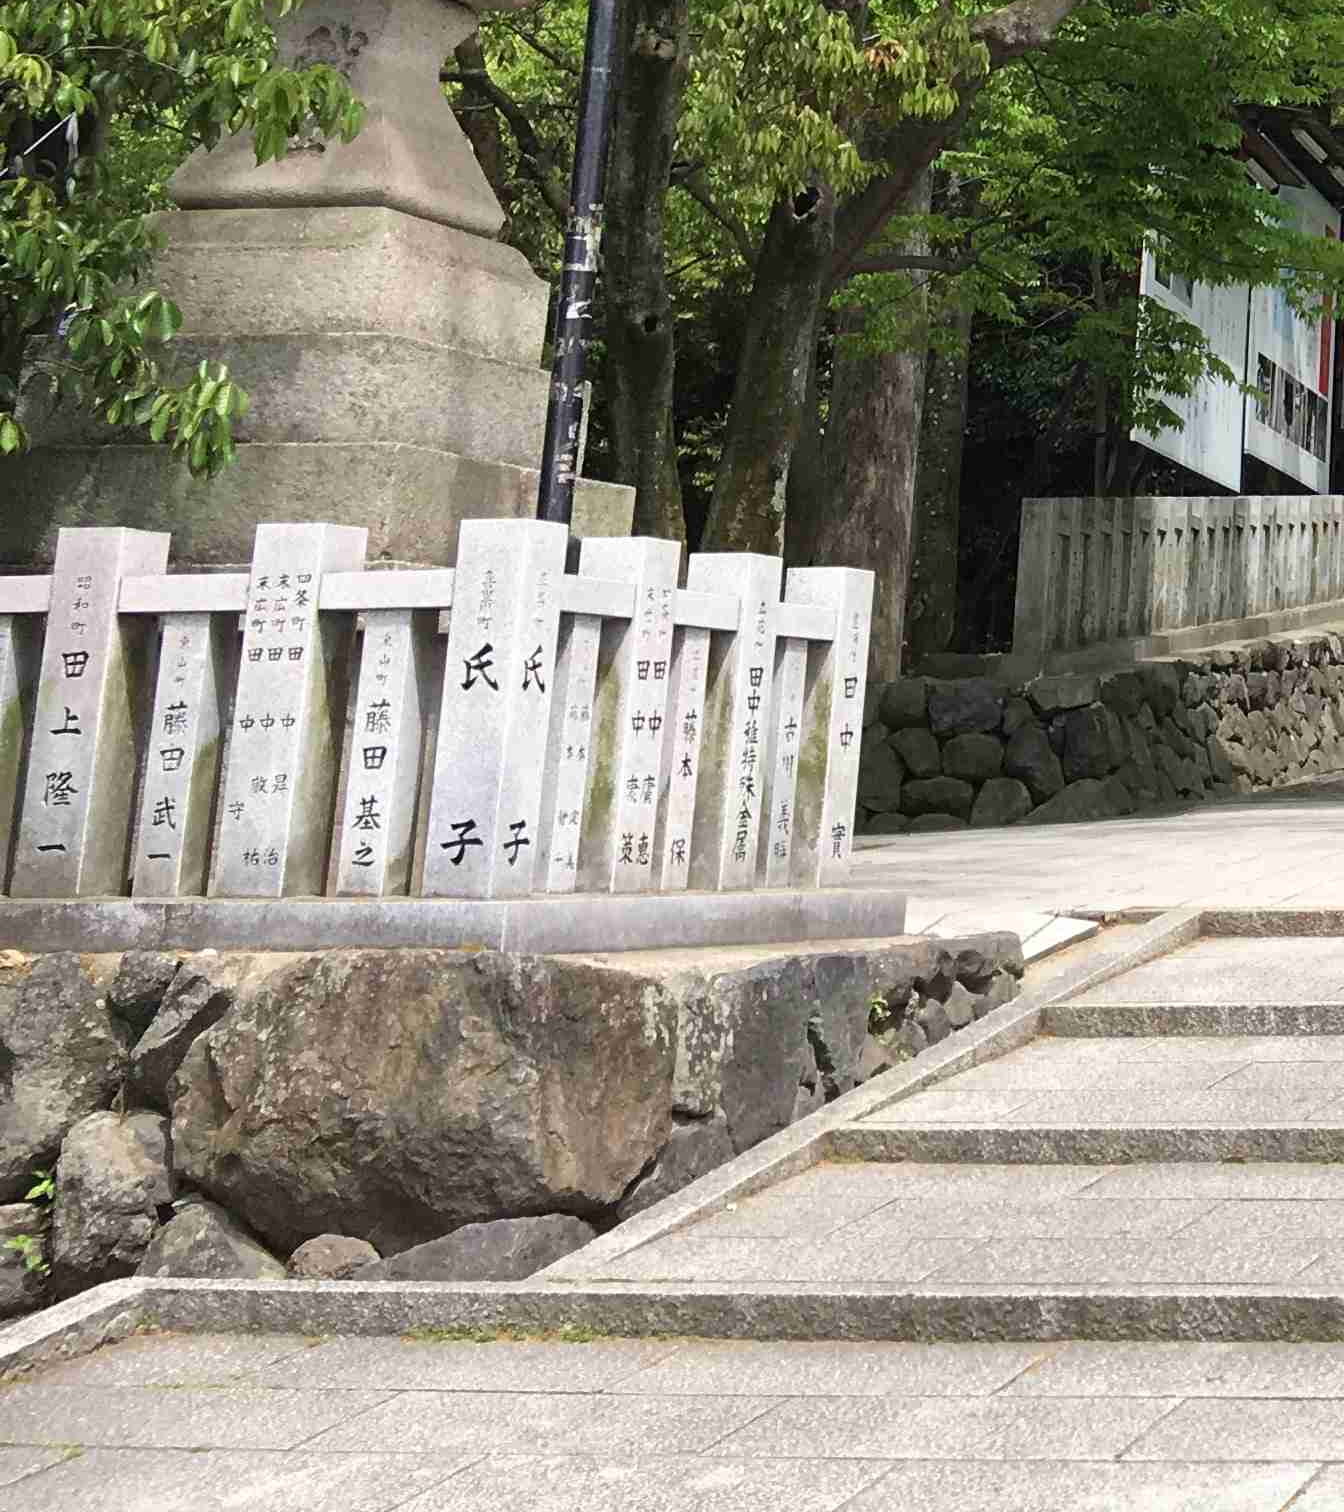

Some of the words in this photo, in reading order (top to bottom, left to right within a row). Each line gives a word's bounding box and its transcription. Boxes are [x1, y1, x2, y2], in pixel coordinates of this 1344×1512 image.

[37, 650, 90, 852] 田上隆一
[351, 698, 391, 867] 藤田基之
[440, 642, 499, 866] 氏子
[503, 644, 545, 866] 氏子
